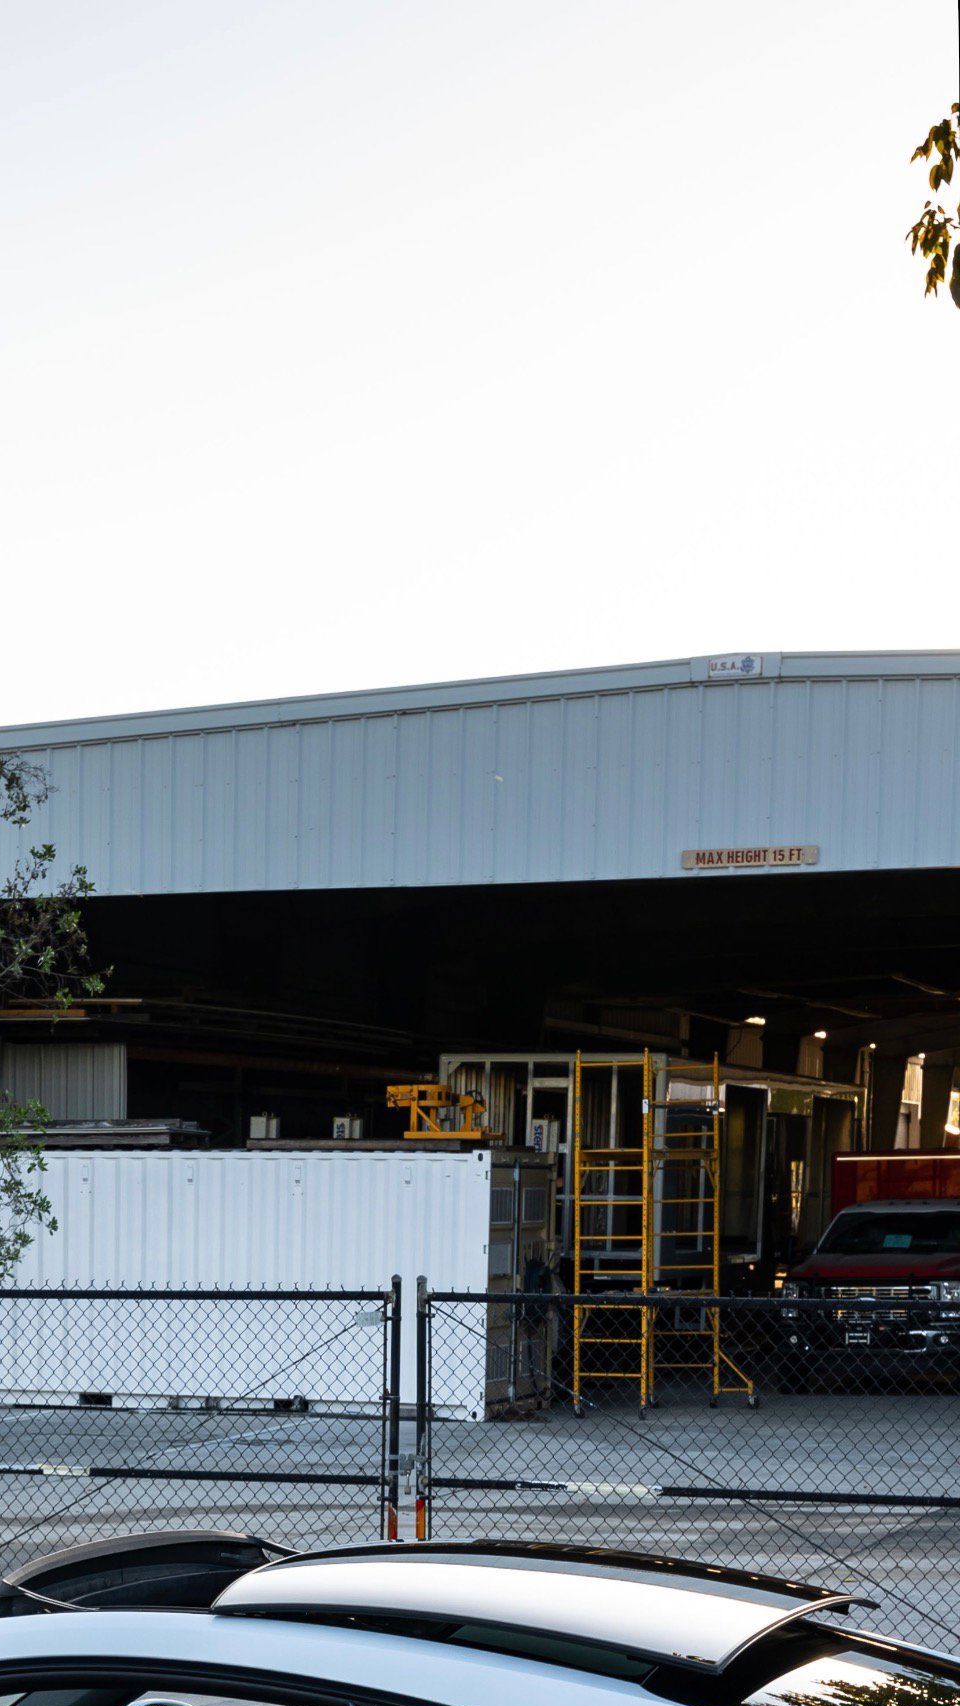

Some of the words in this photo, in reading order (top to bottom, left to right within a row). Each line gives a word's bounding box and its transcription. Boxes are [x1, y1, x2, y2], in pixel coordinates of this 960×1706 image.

[695, 851, 725, 865] MAX
[727, 849, 768, 864] HEIGHT
[773, 849, 785, 862] 15
[789, 848, 802, 862] FT
